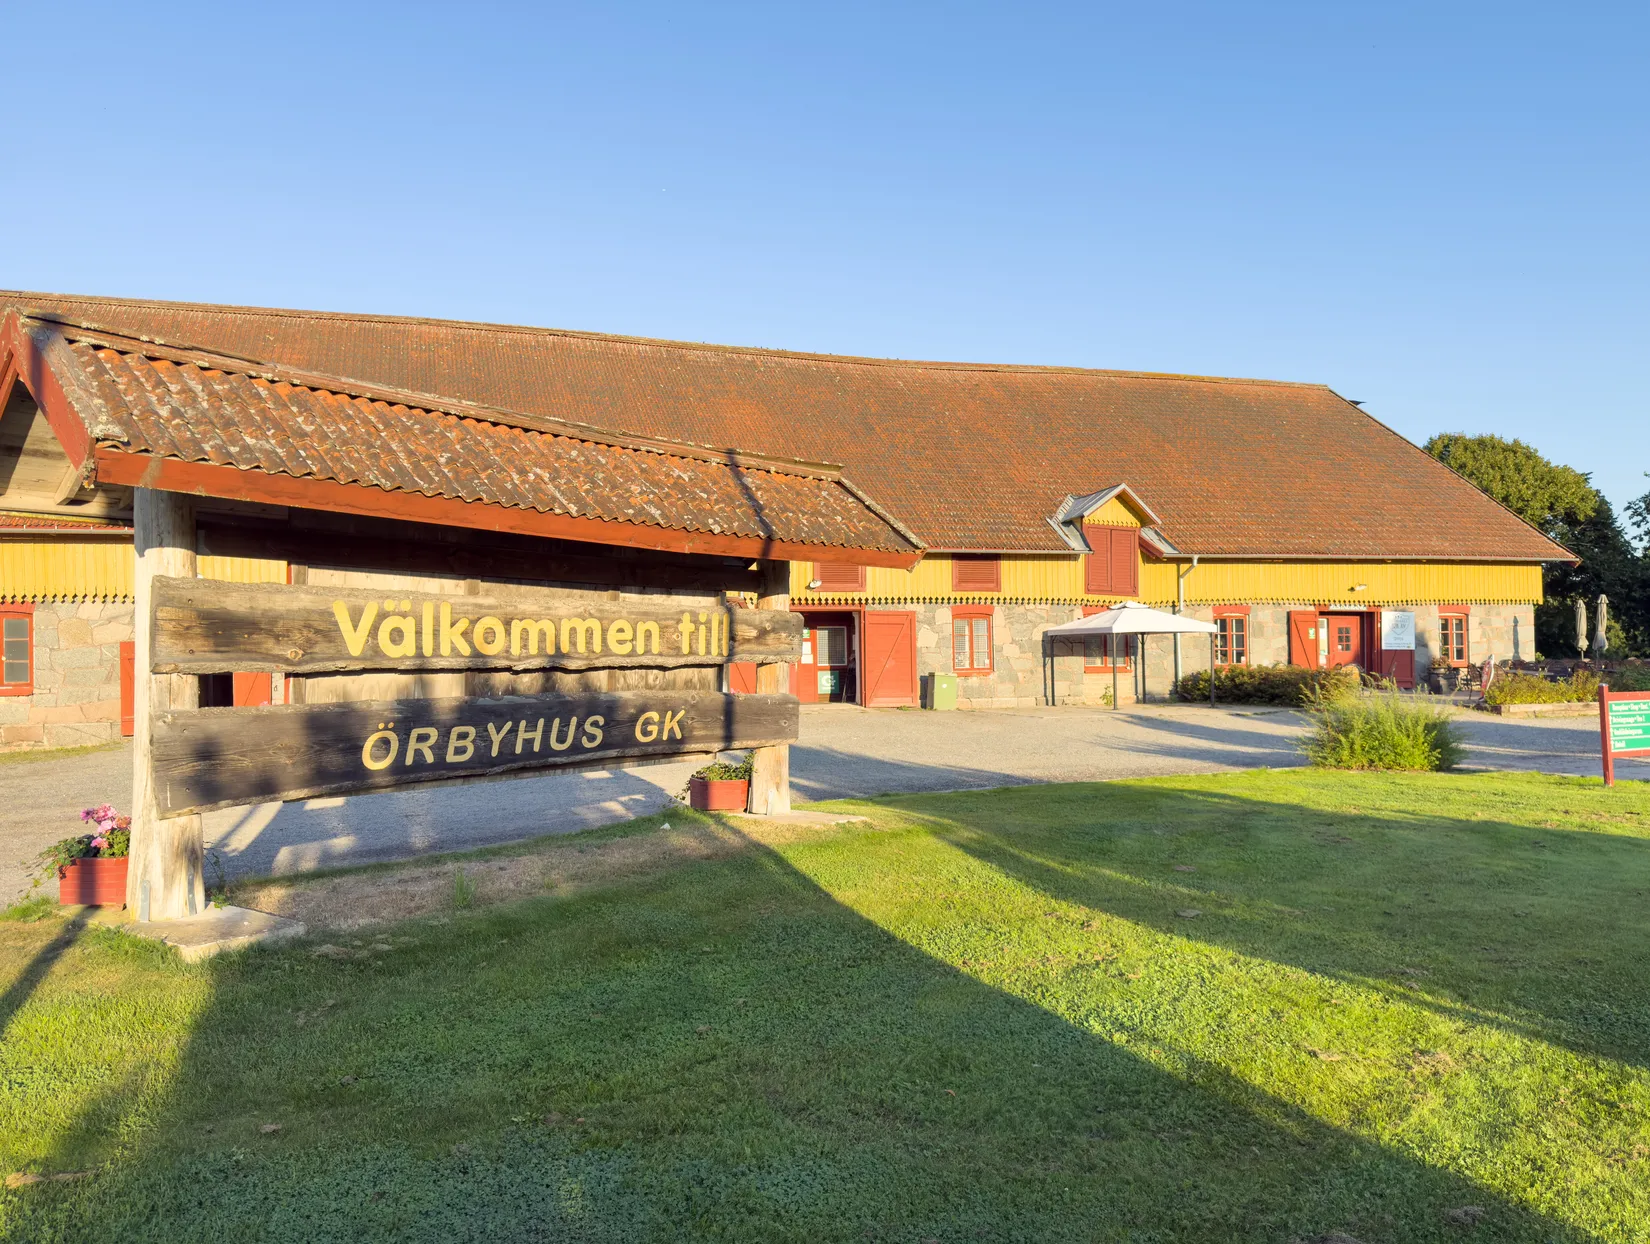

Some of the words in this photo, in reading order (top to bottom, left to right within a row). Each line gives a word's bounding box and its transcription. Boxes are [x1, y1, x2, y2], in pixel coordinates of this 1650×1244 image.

[332, 599, 660, 658] Välkommen
[678, 612, 730, 657] till
[361, 714, 605, 771] ÖRBYHUS
[635, 709, 686, 743] GK
